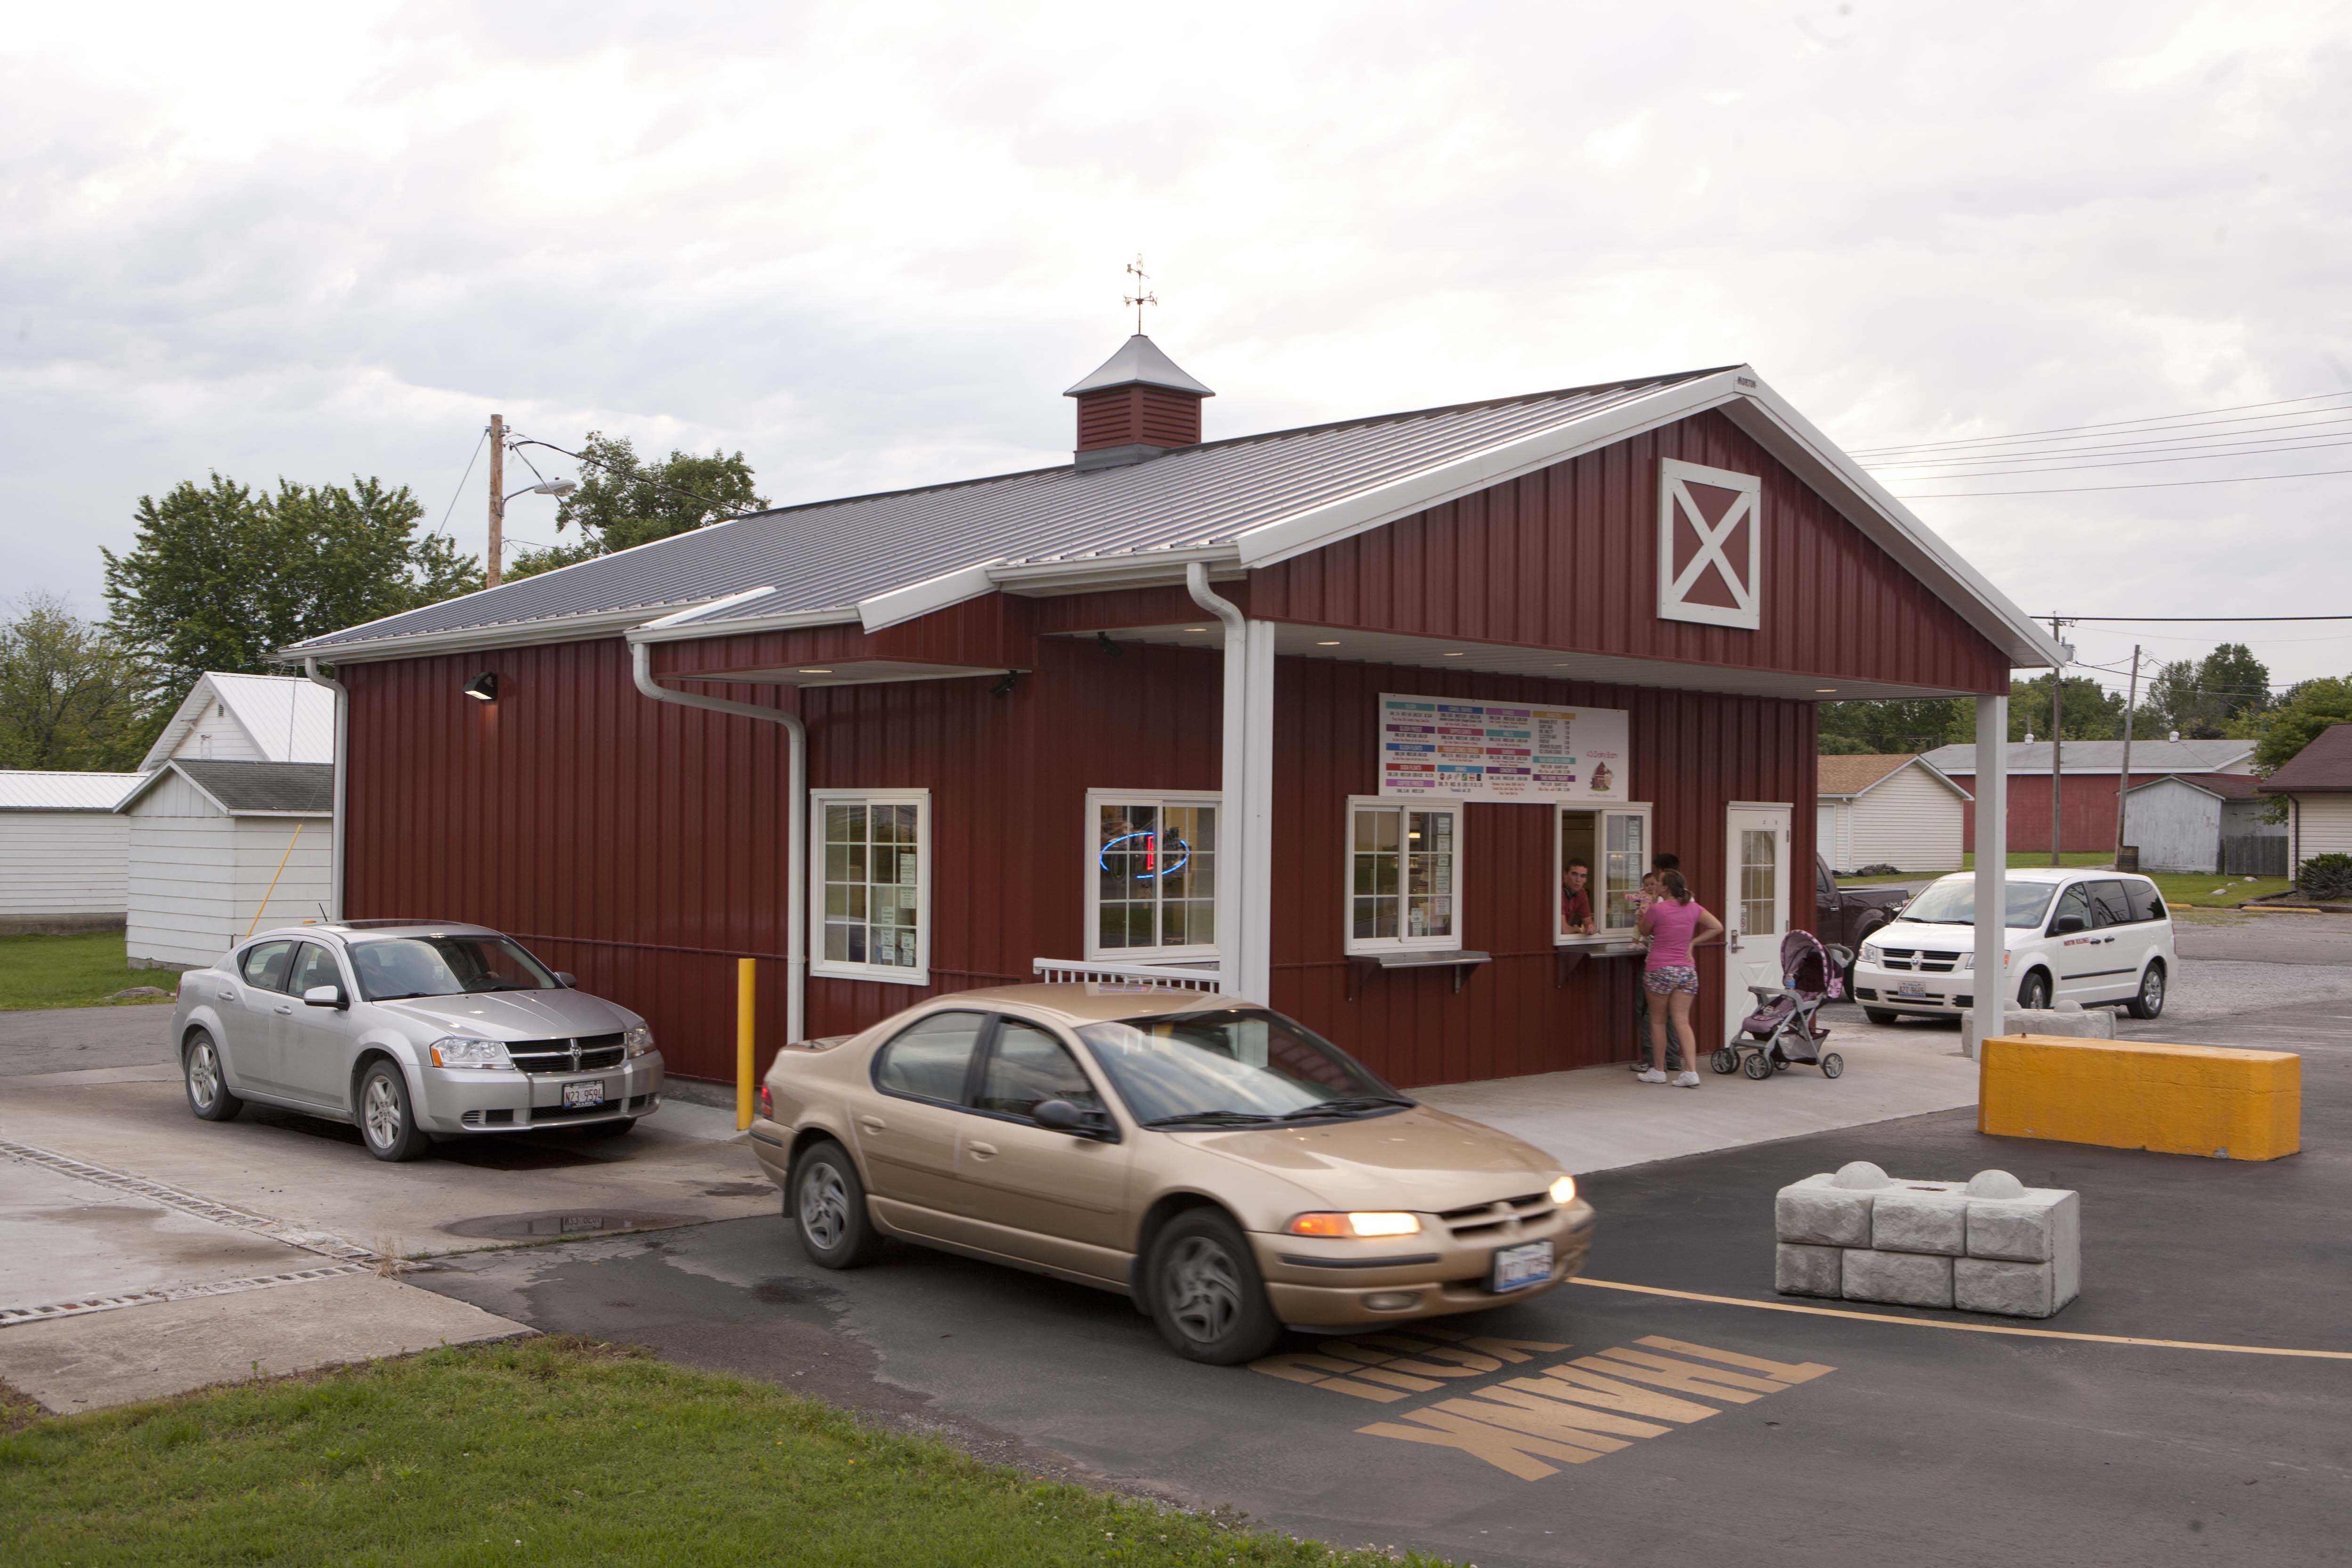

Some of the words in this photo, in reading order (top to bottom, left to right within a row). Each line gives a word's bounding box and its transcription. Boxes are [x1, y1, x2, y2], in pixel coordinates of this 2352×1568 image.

[566, 1091, 580, 1103] N23
[584, 1088, 602, 1102] 9594
[1353, 1335, 1838, 1482] THANK
